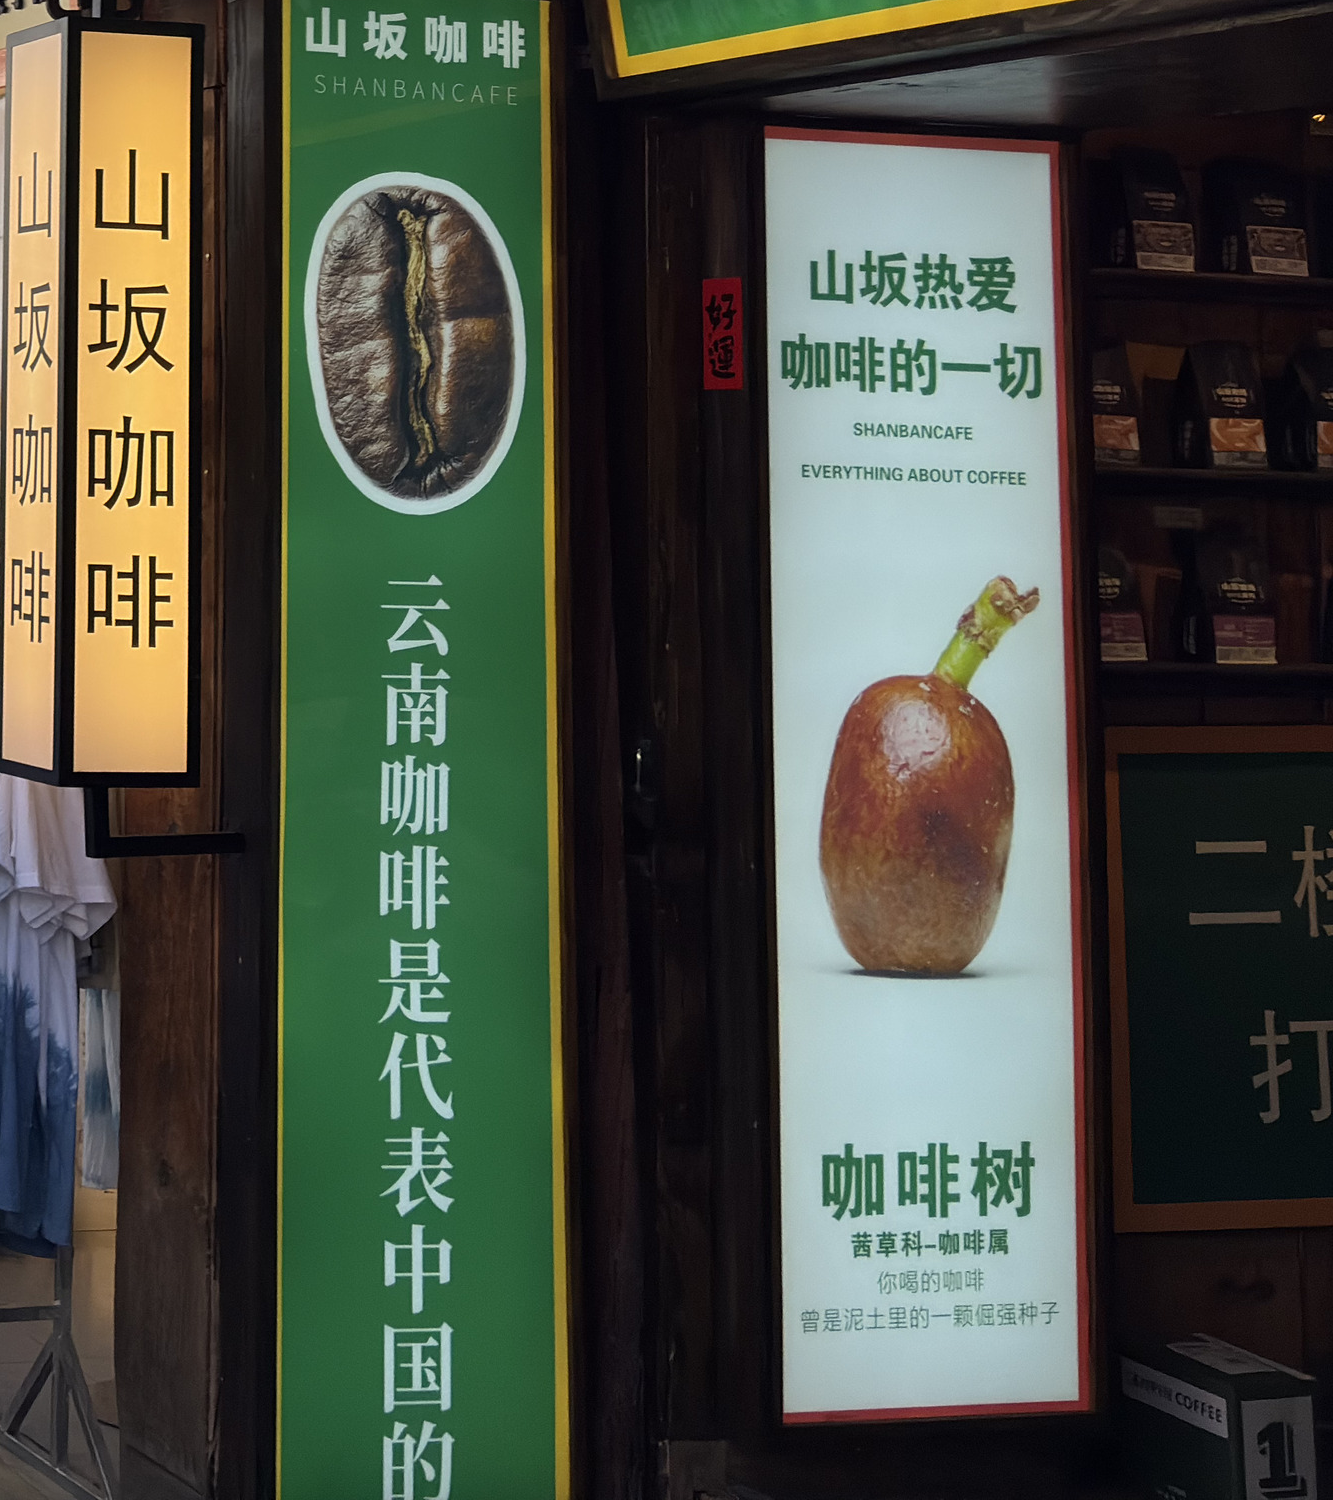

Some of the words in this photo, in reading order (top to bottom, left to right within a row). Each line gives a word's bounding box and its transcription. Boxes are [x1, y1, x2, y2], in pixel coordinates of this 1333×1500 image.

[304, 6, 525, 70] 山坂咖啡
[313, 74, 519, 107] SHANBANCAFE
[809, 249, 1017, 314] 山坂热爱
[11, 150, 53, 645] 山坂咖啡
[781, 333, 1042, 399] 咖啡的一切
[86, 147, 174, 650] 山坂咖啡
[853, 421, 973, 441] SHANBANCAFE
[801, 464, 903, 482] EVERYTHING
[907, 467, 963, 485] ABOUT
[966, 469, 1027, 487] COFFEE
[377, 574, 455, 1500] 云南咖啡是代表中国的
[821, 1140, 1035, 1221] 咖啡树
[851, 1228, 1009, 1258] 茜草科-咖啡属
[877, 1268, 985, 1295] 你喝的咖啡
[800, 1301, 1061, 1334] 曾是泥土里的一颗倔强种子
